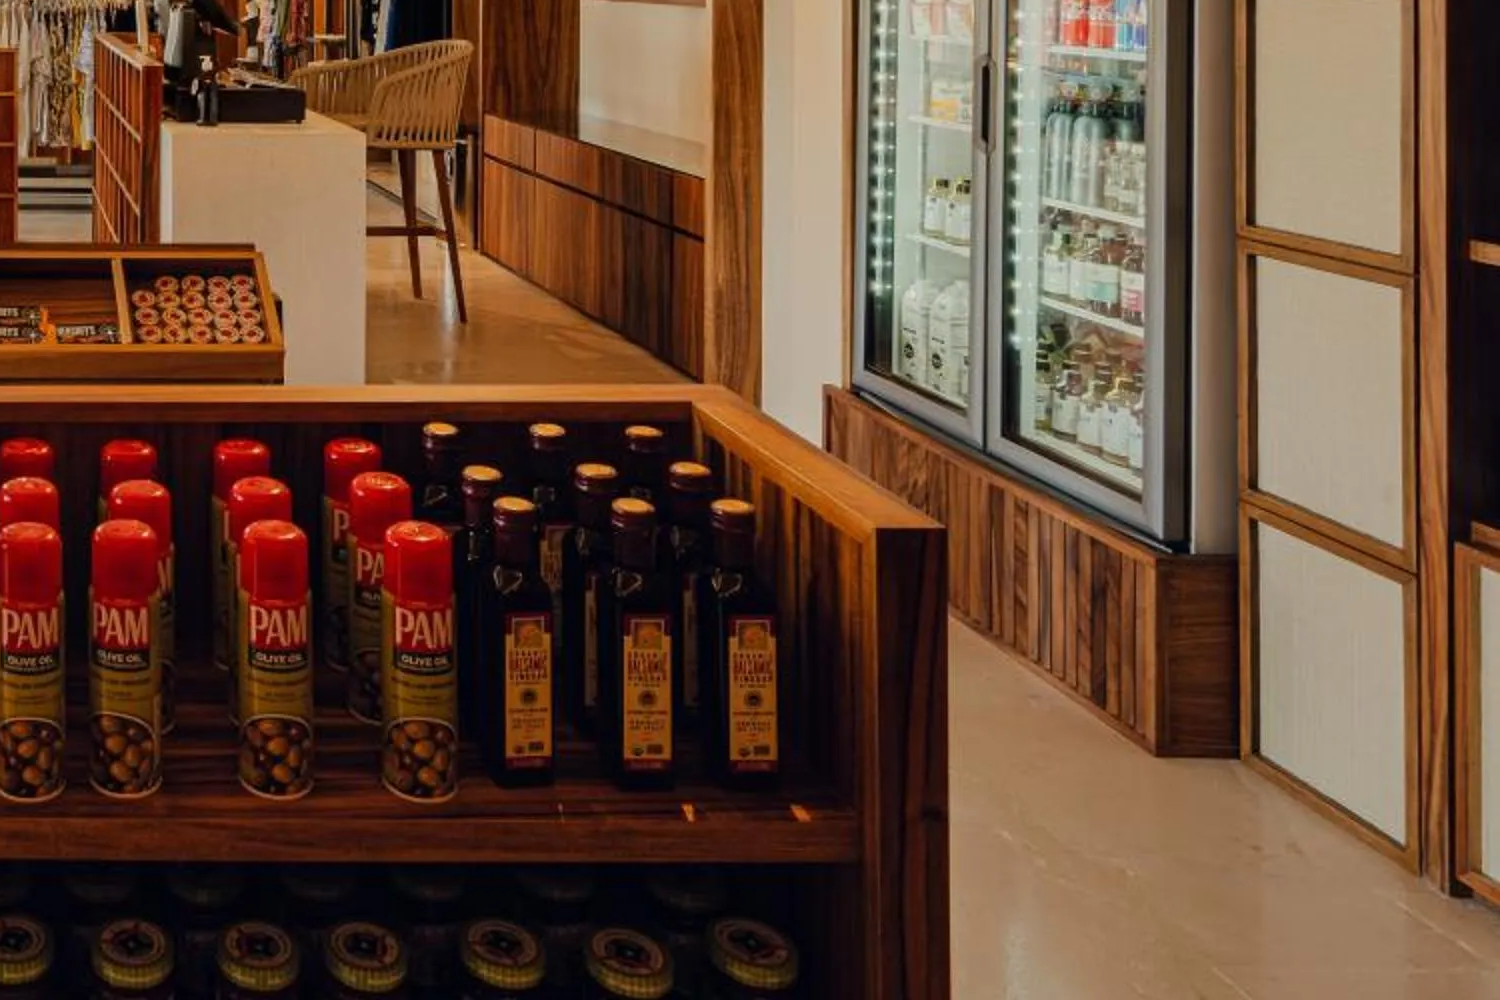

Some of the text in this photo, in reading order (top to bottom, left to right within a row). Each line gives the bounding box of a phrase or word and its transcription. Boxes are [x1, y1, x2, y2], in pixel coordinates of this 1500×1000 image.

[357, 548, 384, 585] PA
[2, 607, 59, 649] PAM
[92, 602, 148, 647] PAM
[250, 605, 307, 647] PAM
[395, 605, 453, 650] PAM
